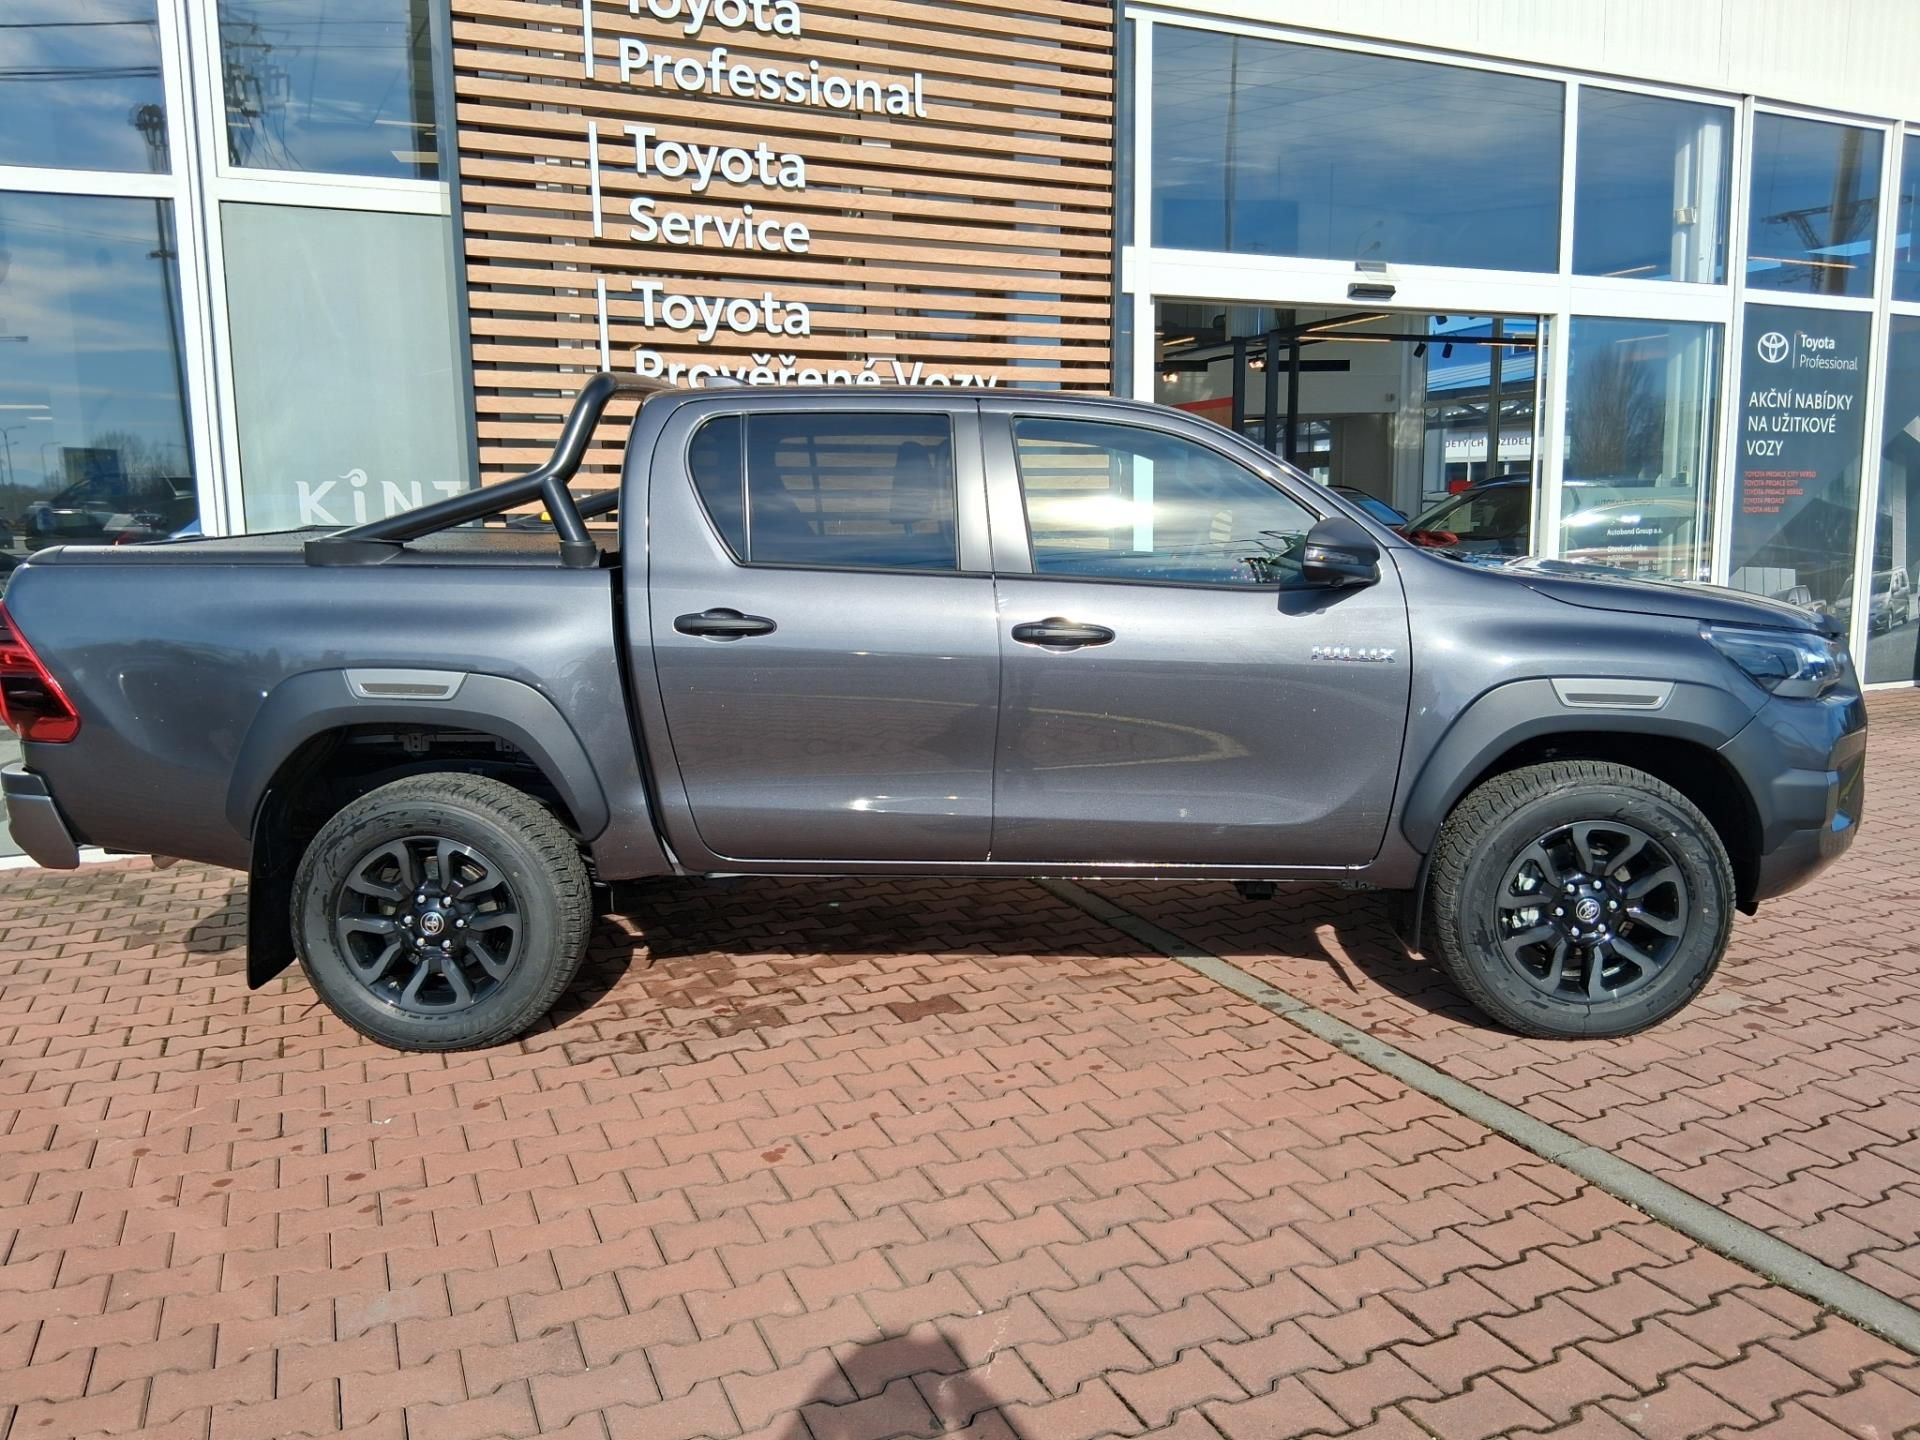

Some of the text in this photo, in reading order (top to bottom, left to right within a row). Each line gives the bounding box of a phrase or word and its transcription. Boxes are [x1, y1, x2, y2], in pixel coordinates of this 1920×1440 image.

[619, 38, 927, 118] Professional
[623, 125, 806, 192] Toyota
[629, 198, 810, 253] Service
[631, 280, 810, 342] Toyota
[1800, 334, 1836, 352] Toyota
[1799, 354, 1858, 371] Professional
[1748, 387, 1854, 411] AKČNÍ NABÍDKY
[1747, 412, 1837, 434] NA UŽITKOVÉ
[1746, 439, 1784, 457] VOZY
